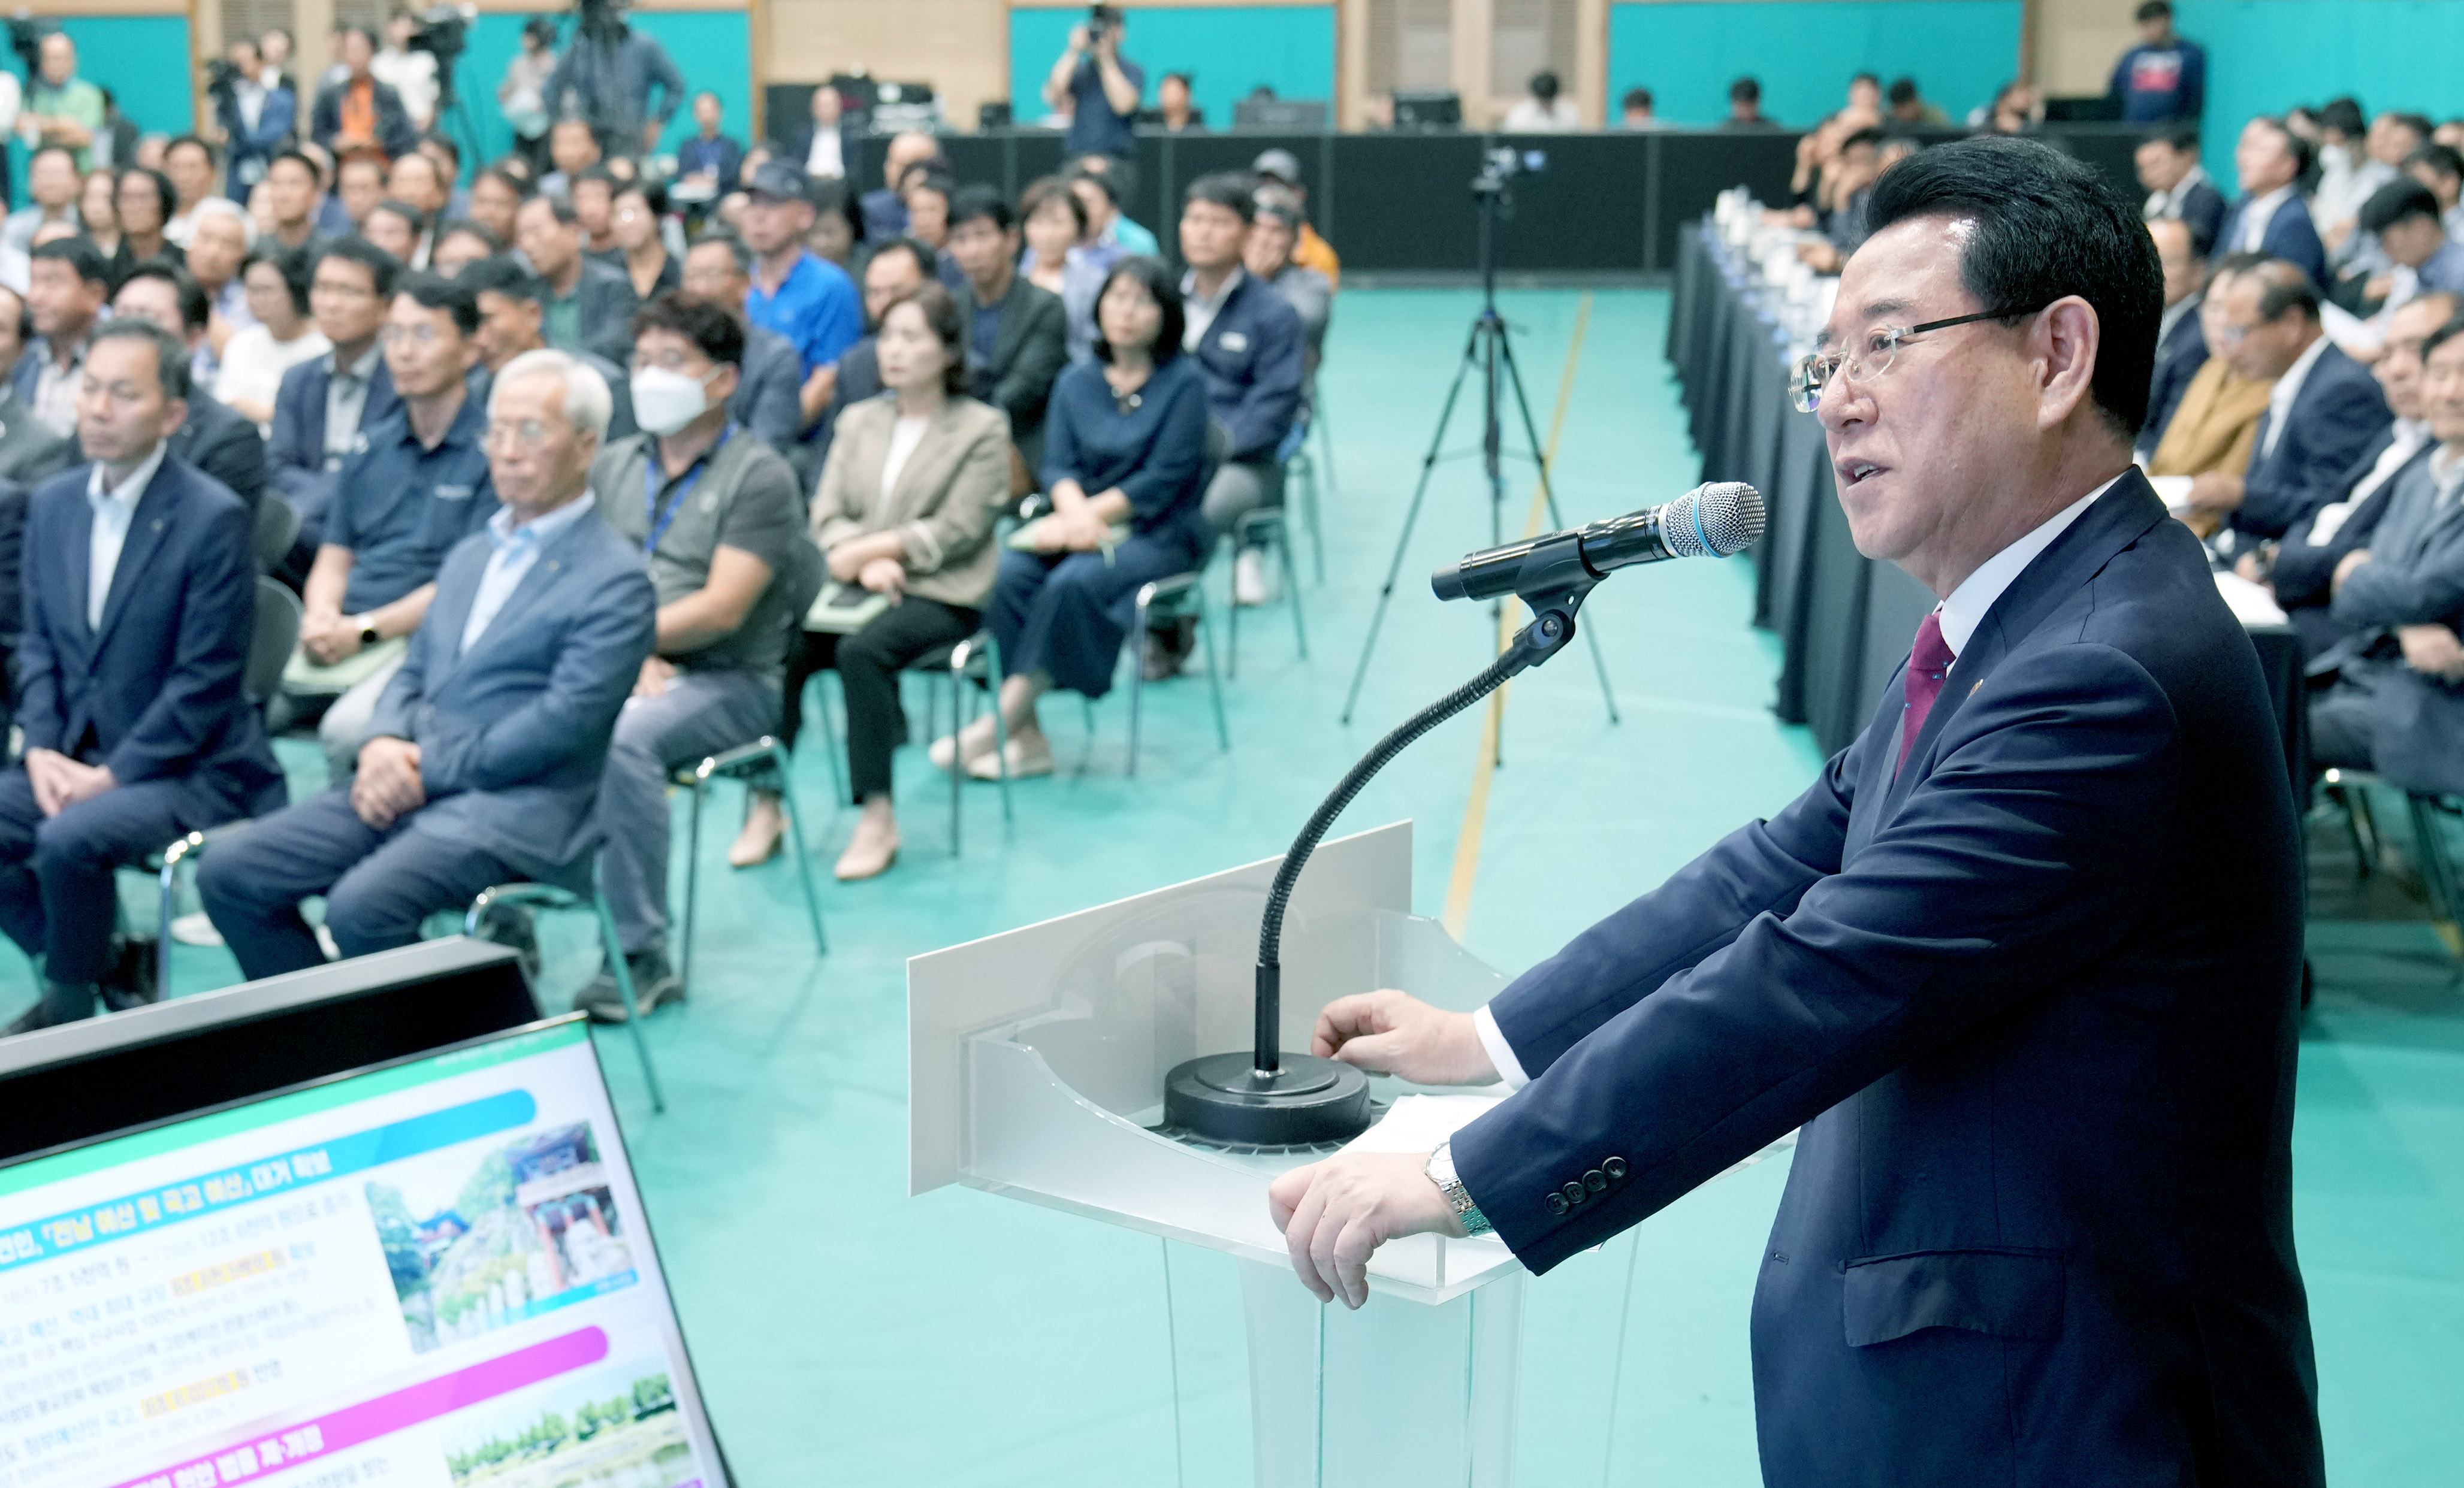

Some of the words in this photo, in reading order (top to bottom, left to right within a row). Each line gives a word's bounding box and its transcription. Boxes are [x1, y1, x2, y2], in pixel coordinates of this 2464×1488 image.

[96, 1205, 135, 1233] 예산
[140, 1198, 159, 1221] 및
[164, 1186, 201, 1214] 국고
[253, 1162, 291, 1190] 대거
[294, 1151, 330, 1178] 확보
[114, 1255, 130, 1275] 원
[201, 1226, 232, 1250] 12조
[277, 1201, 319, 1228] 원으로
[322, 1191, 351, 1215] 증가
[68, 1303, 100, 1327] 역대
[104, 1293, 134, 1316] 최대
[138, 1284, 168, 1306] 규모
[288, 1239, 317, 1261] 확보
[90, 1319, 138, 1345] 신규사업
[25, 1416, 101, 1456] 정부예산안
[252, 1358, 283, 1383] 반영
[37, 1387, 86, 1415] 불교문화
